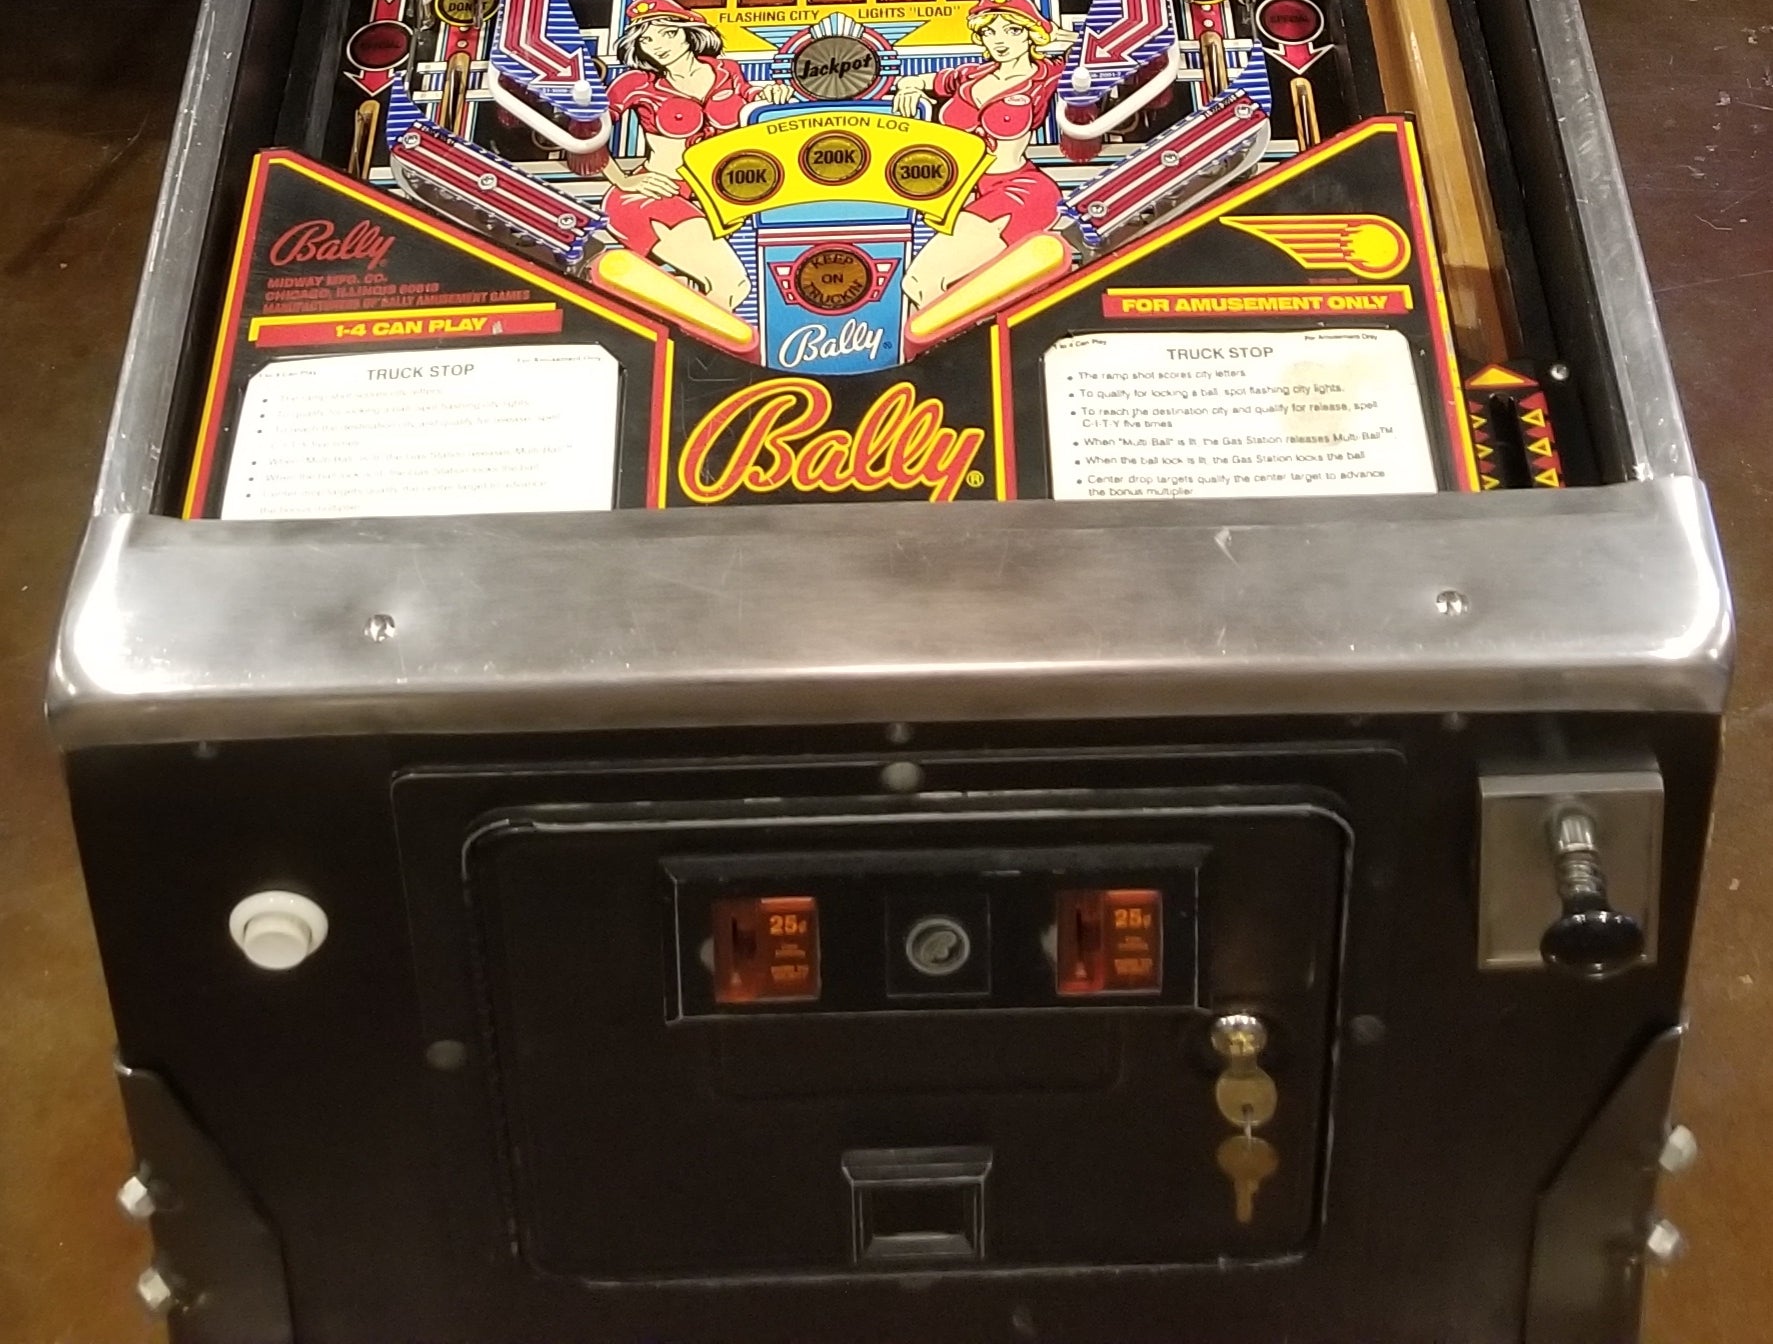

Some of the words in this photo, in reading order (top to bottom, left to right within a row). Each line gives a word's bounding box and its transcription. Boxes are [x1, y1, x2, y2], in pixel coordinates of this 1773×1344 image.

[719, 11, 786, 23] FLASHING
[789, 10, 819, 21] CITY
[858, 8, 906, 19] LIGHTS
[910, 5, 961, 18] "LOAD"
[798, 52, 874, 80] Jackpot
[767, 116, 873, 135] DESTINATION
[876, 117, 910, 134] LOG
[813, 149, 856, 166] 200K
[726, 169, 767, 185] 100K
[899, 163, 944, 180] 300K
[270, 219, 396, 269] Bally
[811, 253, 854, 269] KEEP
[821, 272, 844, 284] ON
[1121, 297, 1171, 314] FOR
[1173, 295, 1327, 312] AMUSEMENT
[1331, 294, 1389, 310] ONLY
[336, 325, 367, 337] 1-4
[373, 321, 423, 336] CAN
[428, 317, 489, 333] PLAY
[778, 318, 884, 368] Bally
[1167, 347, 1225, 360] TRUCK
[1229, 346, 1274, 359] STOP
[367, 366, 424, 380] TRUCK
[429, 363, 475, 378] STOP
[1079, 371, 1098, 380] The
[1102, 373, 1129, 381] ramp
[1132, 371, 1154, 380] shot
[1158, 372, 1192, 380] scores
[1195, 370, 1212, 381] city
[1215, 370, 1246, 378] letters
[1080, 389, 1094, 398] To
[1097, 389, 1130, 400] qualify
[1134, 388, 1147, 397] for
[1151, 389, 1189, 399] locking
[1224, 388, 1247, 397] spot
[1249, 386, 1290, 396] flashing
[1293, 384, 1311, 396] city
[678, 377, 985, 503] Bally
